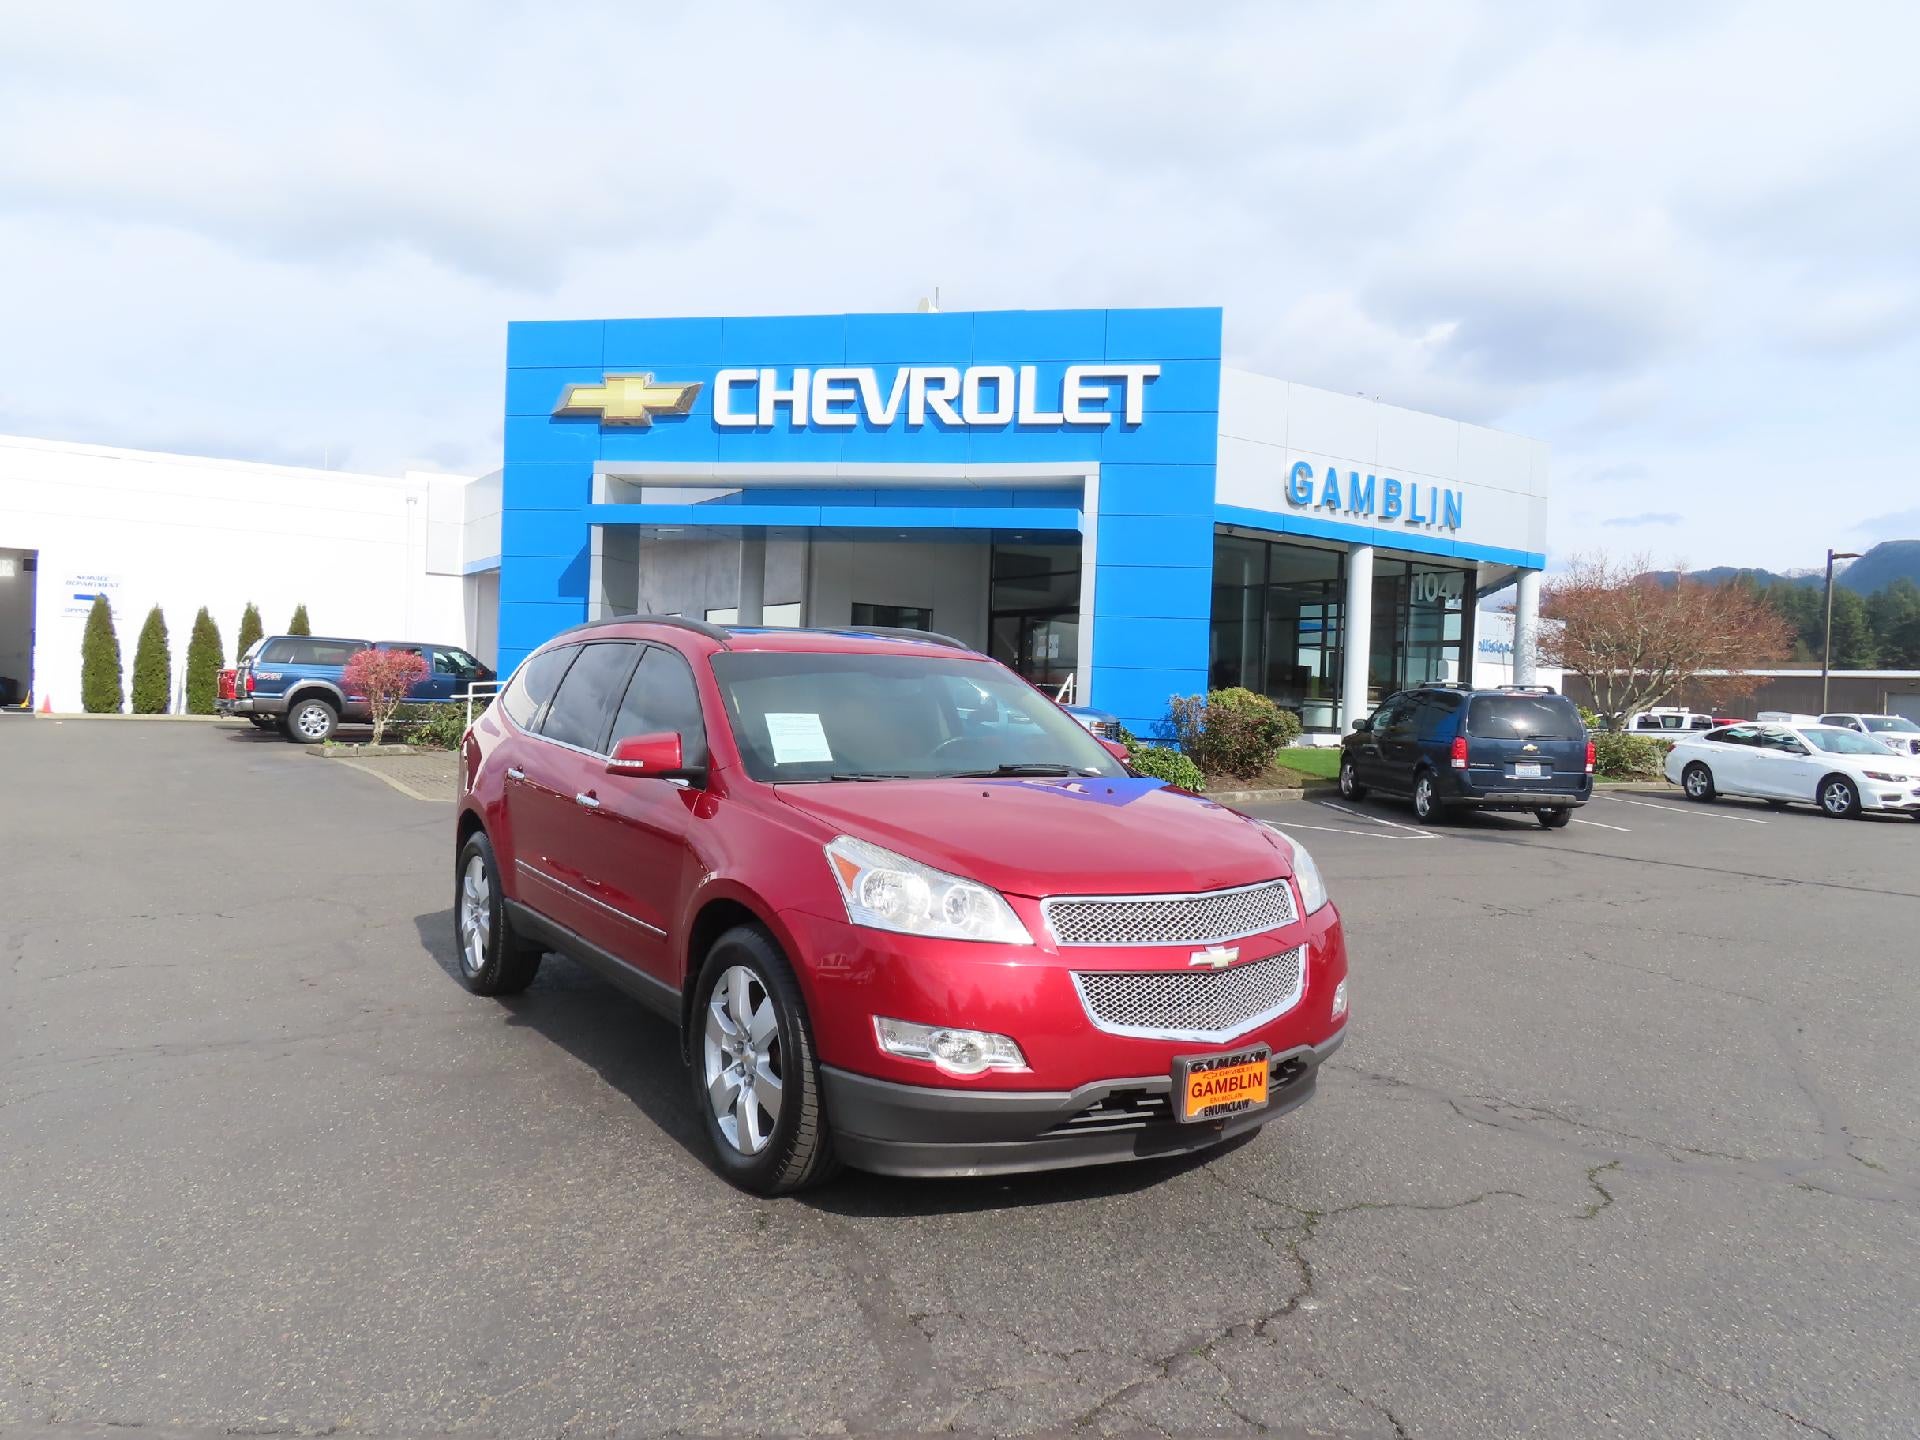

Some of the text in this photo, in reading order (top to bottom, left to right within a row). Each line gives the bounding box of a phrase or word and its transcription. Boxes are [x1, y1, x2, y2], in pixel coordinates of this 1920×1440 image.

[713, 365, 1161, 426] CHEVROLET
[1288, 461, 1462, 529] GAMBLIN
[1191, 1072, 1263, 1098] GAMBLIN
[1204, 1099, 1250, 1117] ENUMCLAW
